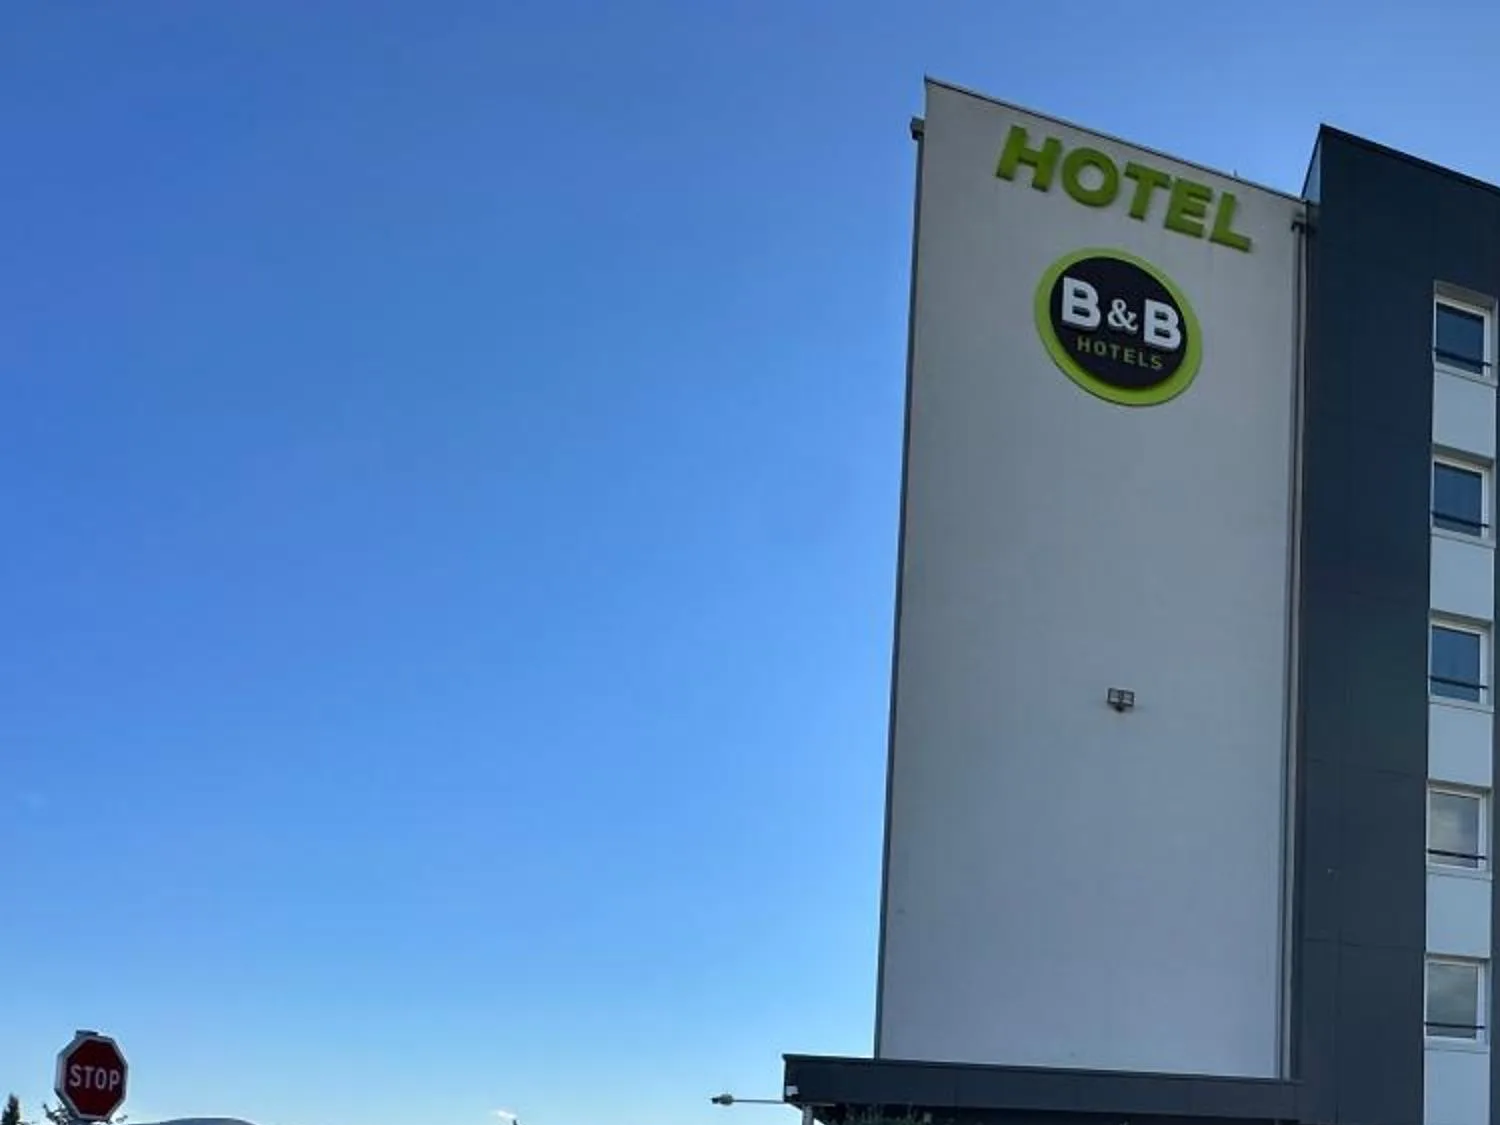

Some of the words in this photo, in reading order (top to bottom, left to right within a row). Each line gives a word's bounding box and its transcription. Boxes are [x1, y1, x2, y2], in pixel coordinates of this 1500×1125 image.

[996, 125, 1253, 253] HOTEL
[1061, 277, 1182, 351] B&B
[1077, 335, 1164, 371] HOTELS
[69, 1064, 120, 1091] STOP
